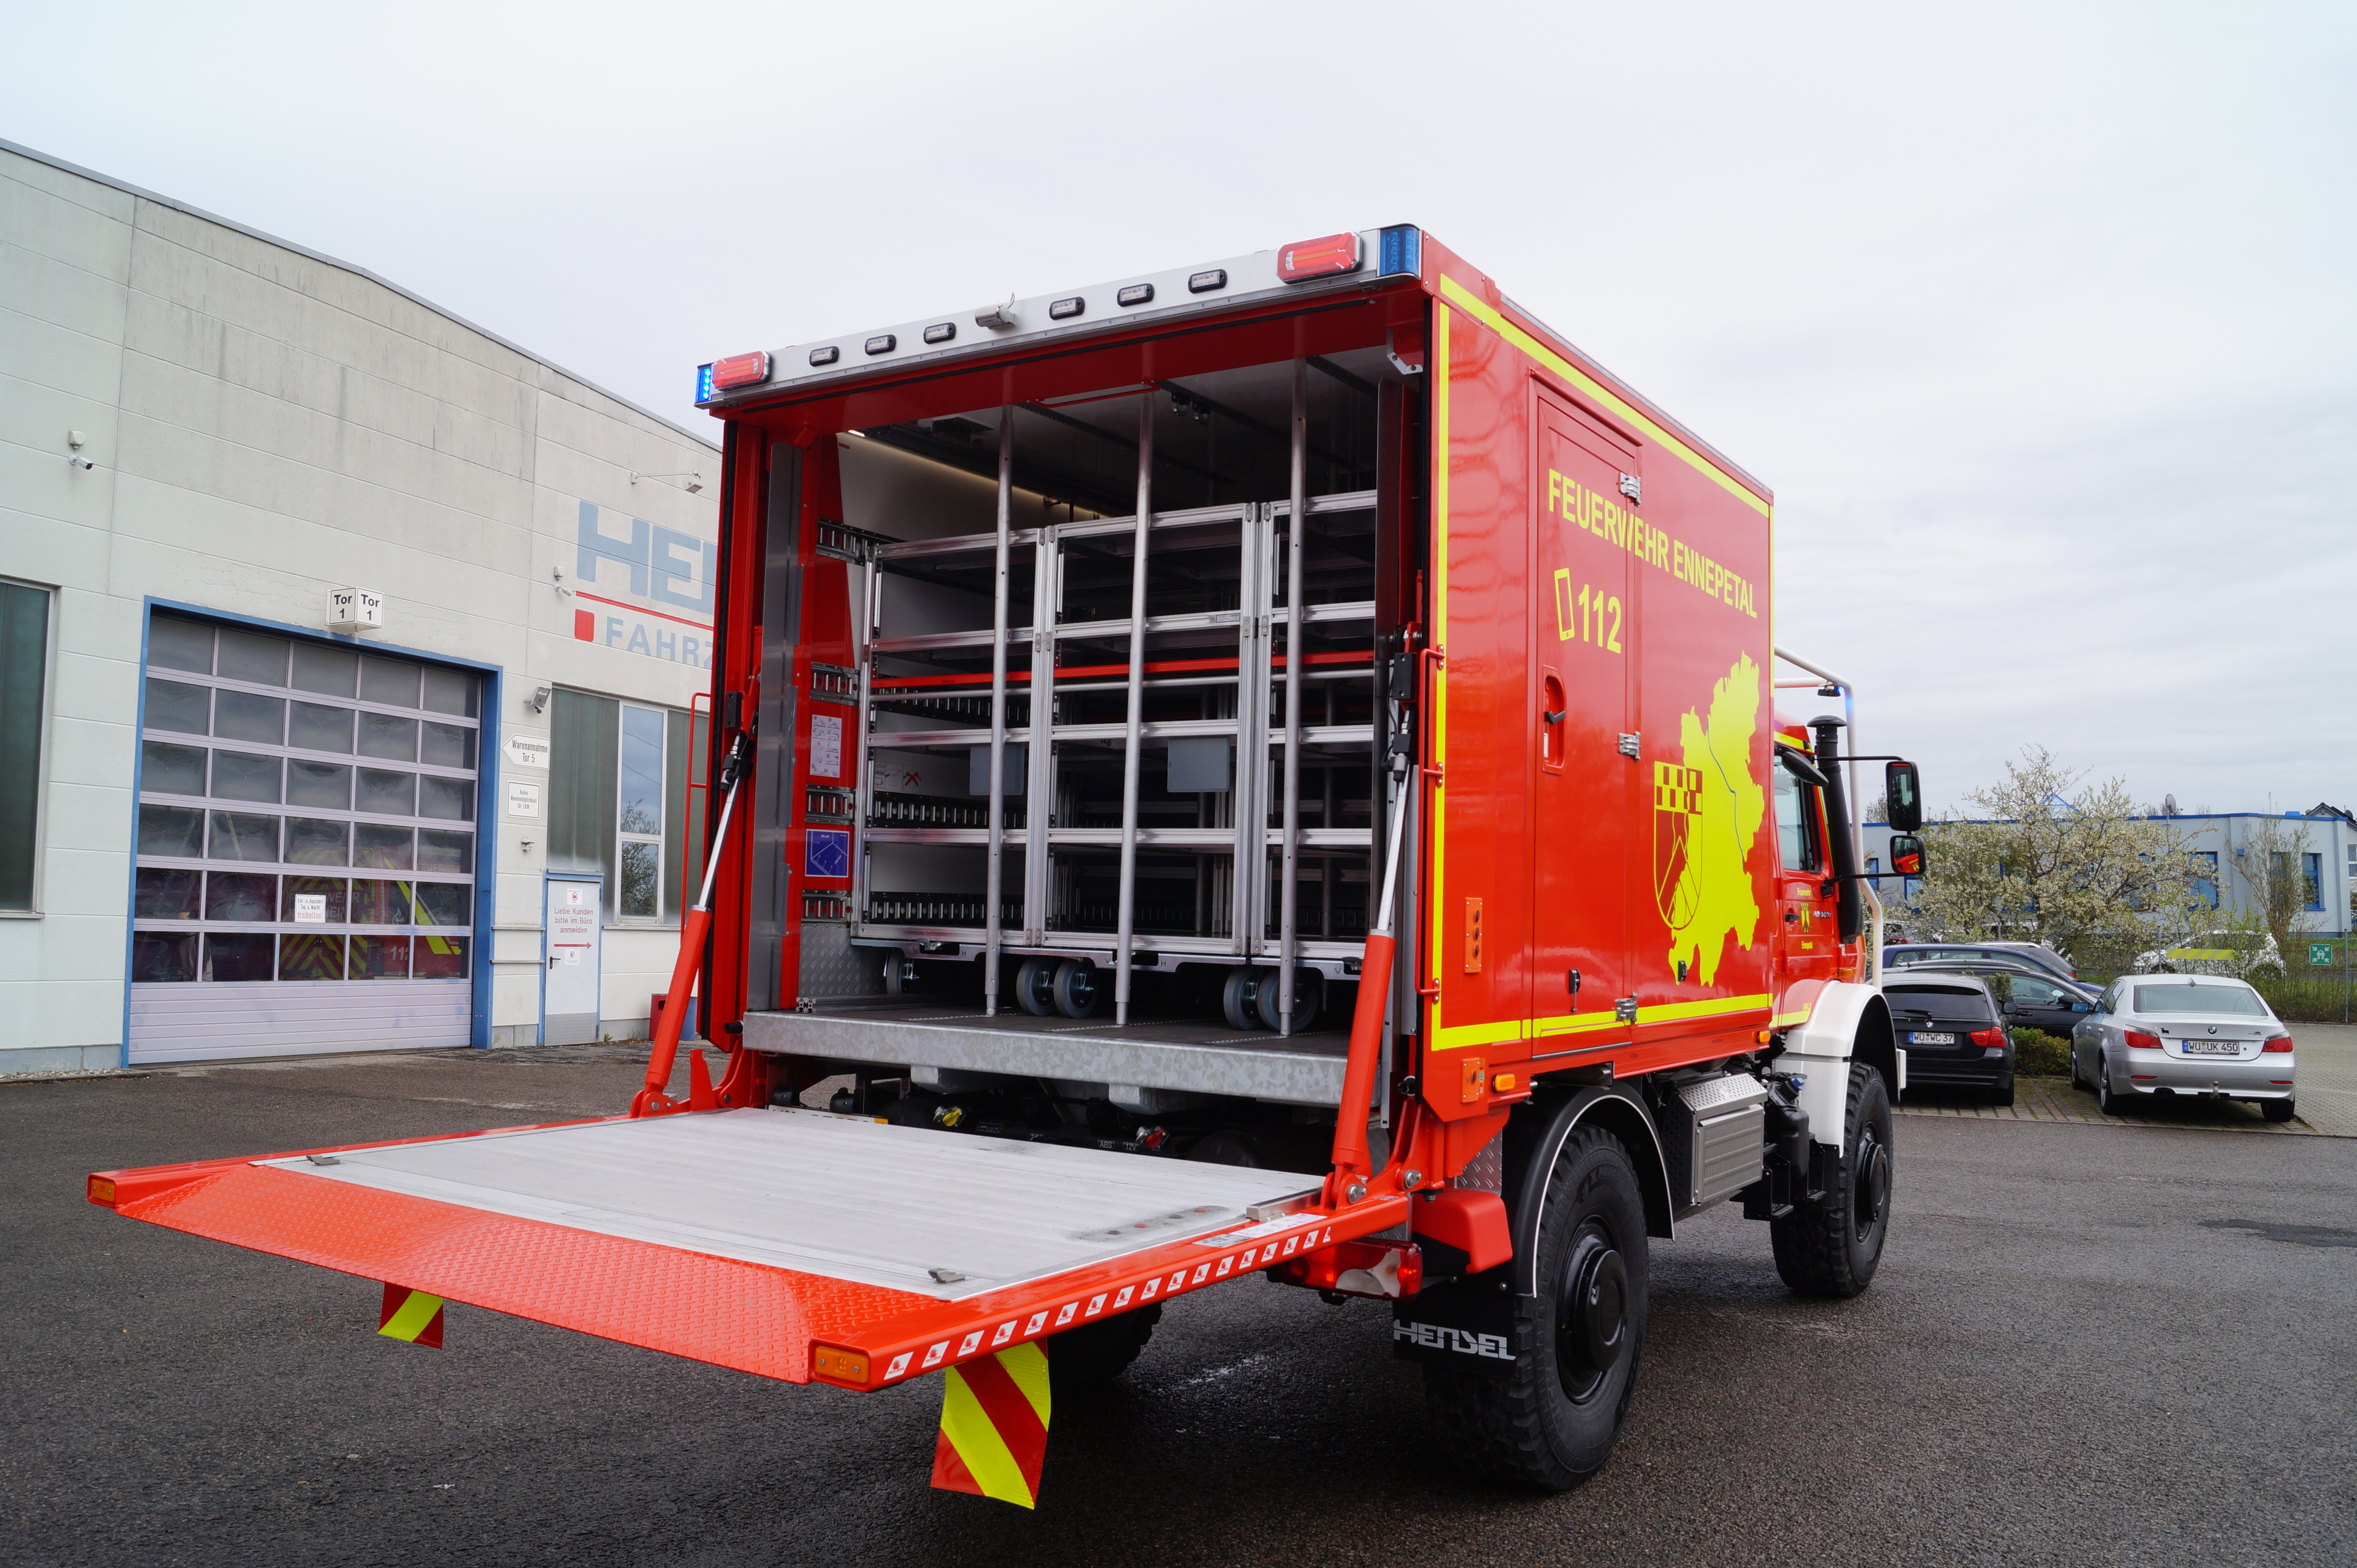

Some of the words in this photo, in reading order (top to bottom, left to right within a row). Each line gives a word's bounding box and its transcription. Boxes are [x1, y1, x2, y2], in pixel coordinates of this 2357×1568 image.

[1549, 468, 1670, 572] FEUERWEHR
[1673, 539, 1757, 618] ENNEPETAL
[334, 594, 353, 606] Tor
[360, 593, 380, 608] Tor
[339, 608, 345, 619] 1
[366, 610, 372, 621] 1
[1578, 584, 1622, 654] 112
[512, 739, 548, 754] Warenannahme
[522, 752, 530, 762] Tor
[531, 754, 535, 763] 5
[1930, 1034, 1941, 1042] WC
[2188, 1041, 2201, 1051] WÜ
[2207, 1042, 2219, 1051] UK
[2221, 1043, 2238, 1052] 450
[1393, 1319, 1517, 1360] HENSEL
